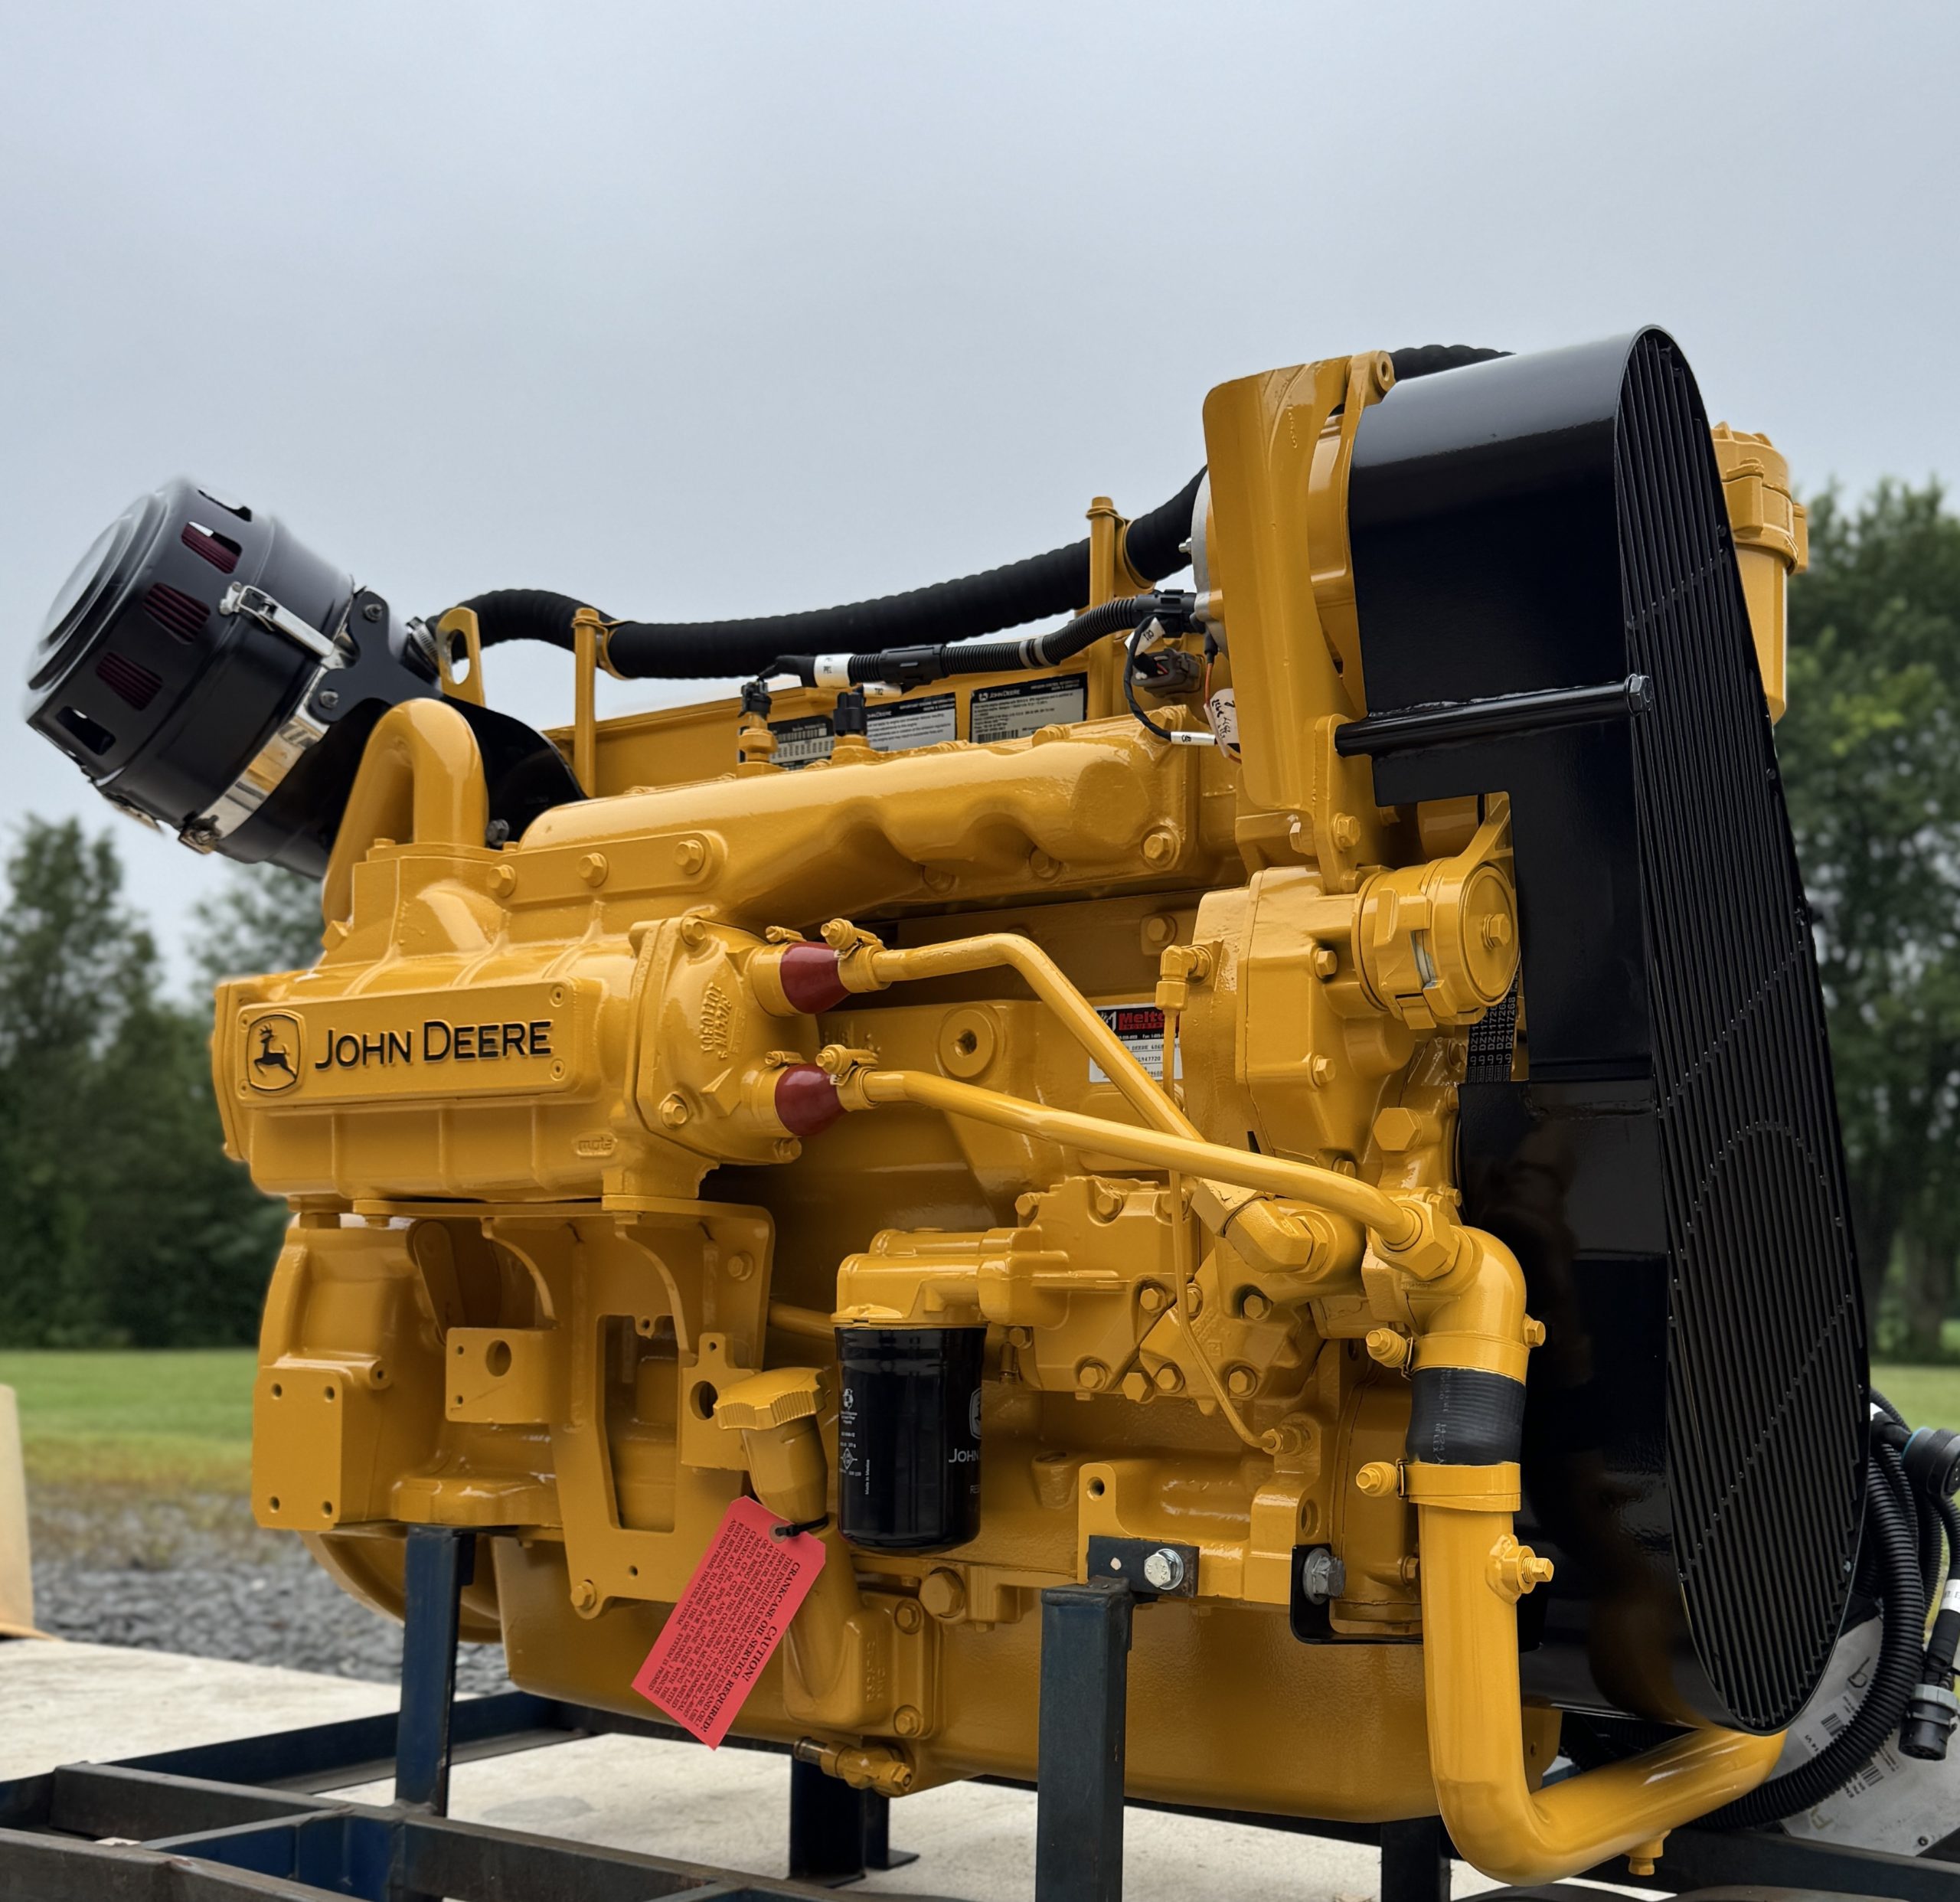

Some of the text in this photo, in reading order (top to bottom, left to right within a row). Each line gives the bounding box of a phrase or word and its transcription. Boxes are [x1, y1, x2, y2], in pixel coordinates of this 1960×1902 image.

[1505, 997, 1515, 1049] DZ117268
[315, 1021, 551, 1069] JOHN DEERE
[726, 1518, 737, 1533] AND
[731, 1521, 744, 1540] REST
[717, 1532, 730, 1550] THEN
[732, 1526, 750, 1554] STARTER
[759, 1538, 769, 1551] OIL
[766, 1543, 775, 1552] AS
[706, 1549, 720, 1570] PRIME
[726, 1554, 735, 1564] AT
[732, 1530, 757, 1570] CRANKCASE
[743, 1559, 757, 1580] BEING
[760, 1567, 769, 1579] OIL
[769, 1552, 786, 1579] SERVICE
[780, 1556, 792, 1572] THE
[698, 1570, 709, 1584] THE
[708, 1570, 717, 1581] TO
[714, 1563, 730, 1585] LEAST
[690, 1582, 702, 1599] FUEL
[694, 1580, 711, 1606] ENSURE
[733, 1580, 746, 1597] USED
[753, 1577, 763, 1591] PER
[760, 1577, 773, 1595] WITH
[765, 1570, 785, 1600] ENGINE
[701, 1590, 715, 1610] TIMES
[714, 1586, 726, 1602] SPIN
[727, 1585, 751, 1622] REFERENCE
[752, 1593, 763, 1608] THE
[686, 1606, 697, 1620] THE
[704, 1603, 716, 1618] THE
[714, 1600, 726, 1616] AND
[725, 1598, 736, 1612] THE
[756, 1599, 769, 1615] HAS
[680, 1619, 690, 1632] OIL
[693, 1610, 704, 1624] FOR
[736, 1606, 756, 1636] CORRECT
[745, 1614, 760, 1636] BEEN
[690, 1619, 707, 1644] ENGINE
[704, 1612, 727, 1649] CONTAINER
[729, 1623, 738, 1633] OR
[665, 1632, 683, 1659] SYSTEM
[692, 1634, 707, 1655] AFTER
[700, 1560, 801, 1733] CRANKCASE OIL SERVICE REQUIRED!
[716, 1633, 732, 1657] ARCTIC
[720, 1636, 739, 1664] AMOUNT
[728, 1633, 749, 1665] PURGED
[741, 1625, 778, 1681] CAUTION!
[661, 1657, 668, 1665] IS
[678, 1645, 692, 1665] OVER
[693, 1649, 707, 1668] MUST
[710, 1656, 719, 1668] OIL
[668, 1665, 681, 1684] WITH
[676, 1657, 694, 1684] FILLING
[688, 1668, 696, 1678] BE
[702, 1668, 712, 1681] PER
[715, 1662, 724, 1673] OF
[722, 1664, 732, 1675] OF
[652, 1668, 671, 1695] MINUTE
[677, 1669, 704, 1712] COMMERCIAL
[702, 1672, 719, 1696] ENGINE
[712, 1674, 726, 1694] FUEL
[658, 1685, 670, 1700] THE
[665, 1685, 678, 1704] WITH
[671, 1678, 690, 1708] LABELED
[702, 1691, 716, 1711] AND
